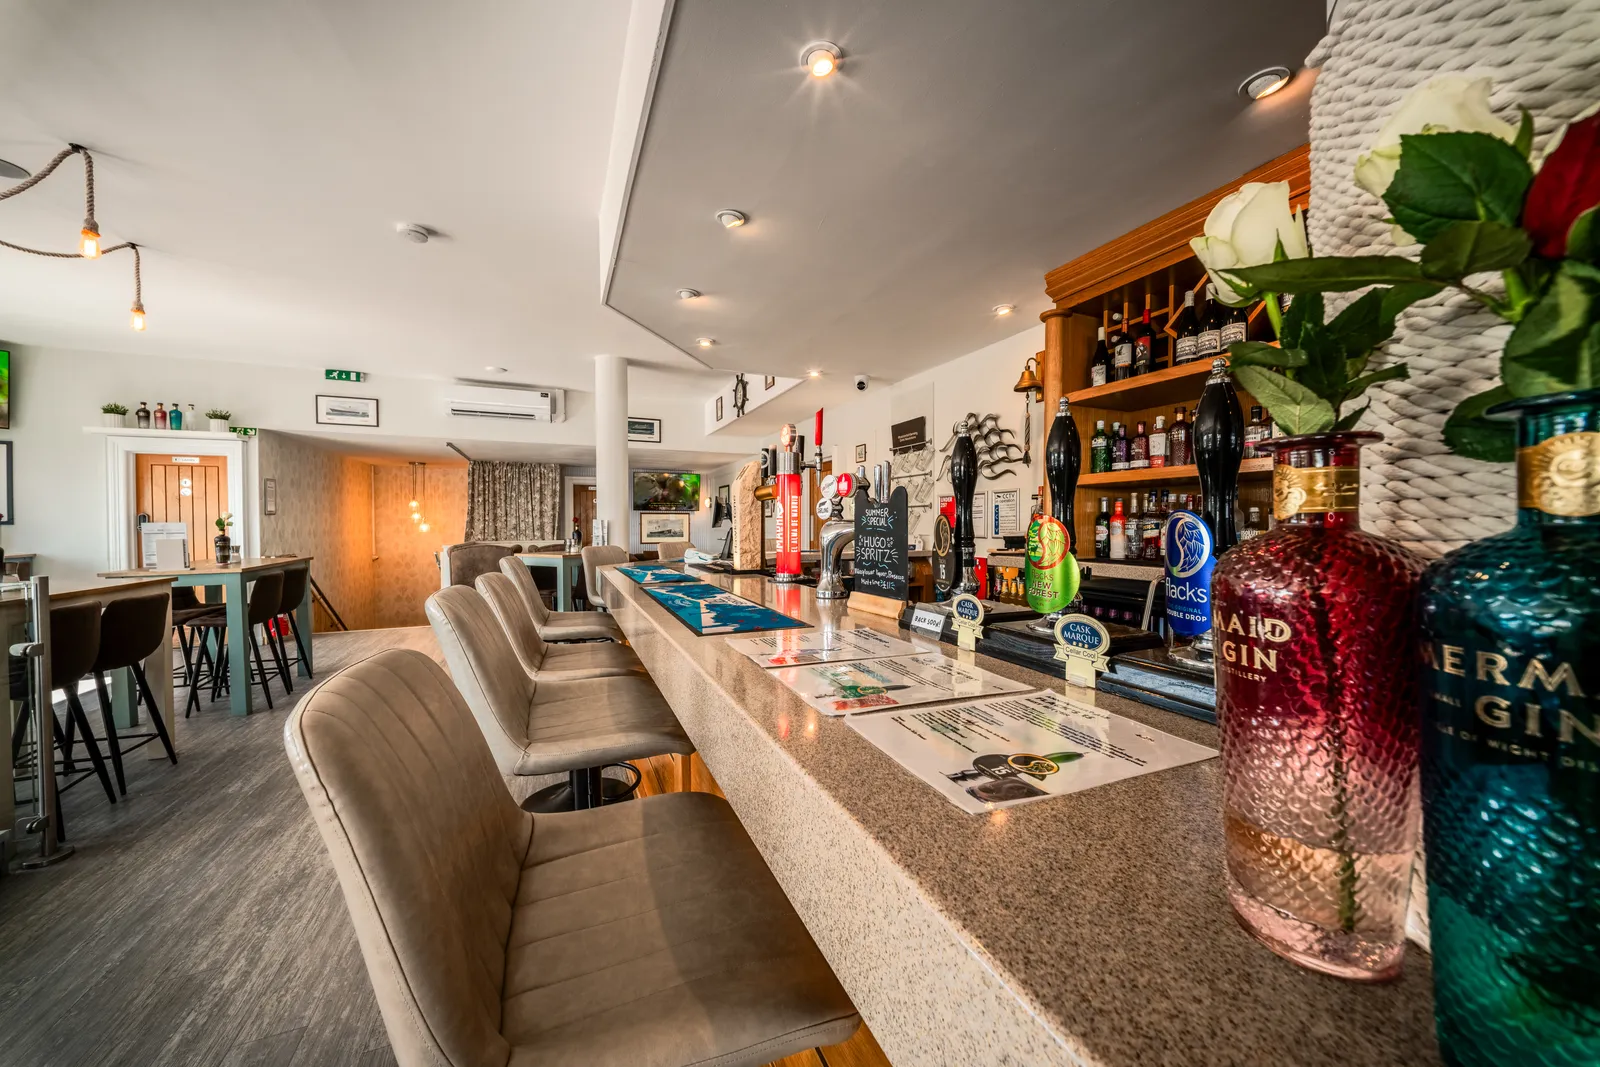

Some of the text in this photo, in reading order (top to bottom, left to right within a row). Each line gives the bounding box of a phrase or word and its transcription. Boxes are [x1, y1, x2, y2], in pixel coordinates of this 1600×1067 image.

[865, 508, 889, 517] SUMMER
[867, 516, 888, 526] SPECIAL
[863, 536, 886, 548] HUGO
[861, 548, 891, 562] SPRITZ
[939, 564, 946, 579] 15
[1032, 581, 1051, 590] NEW
[1028, 587, 1058, 598] FOREST
[958, 607, 978, 617] MARQUE
[1167, 608, 1207, 622] DOUBLE DROP
[914, 615, 927, 623] BACK
[1069, 623, 1092, 635] CASK
[1063, 631, 1100, 645] MARQUE
[1065, 646, 1081, 655] Cellar
[1222, 640, 1278, 672] GIN
[1475, 695, 1600, 747] GIN
